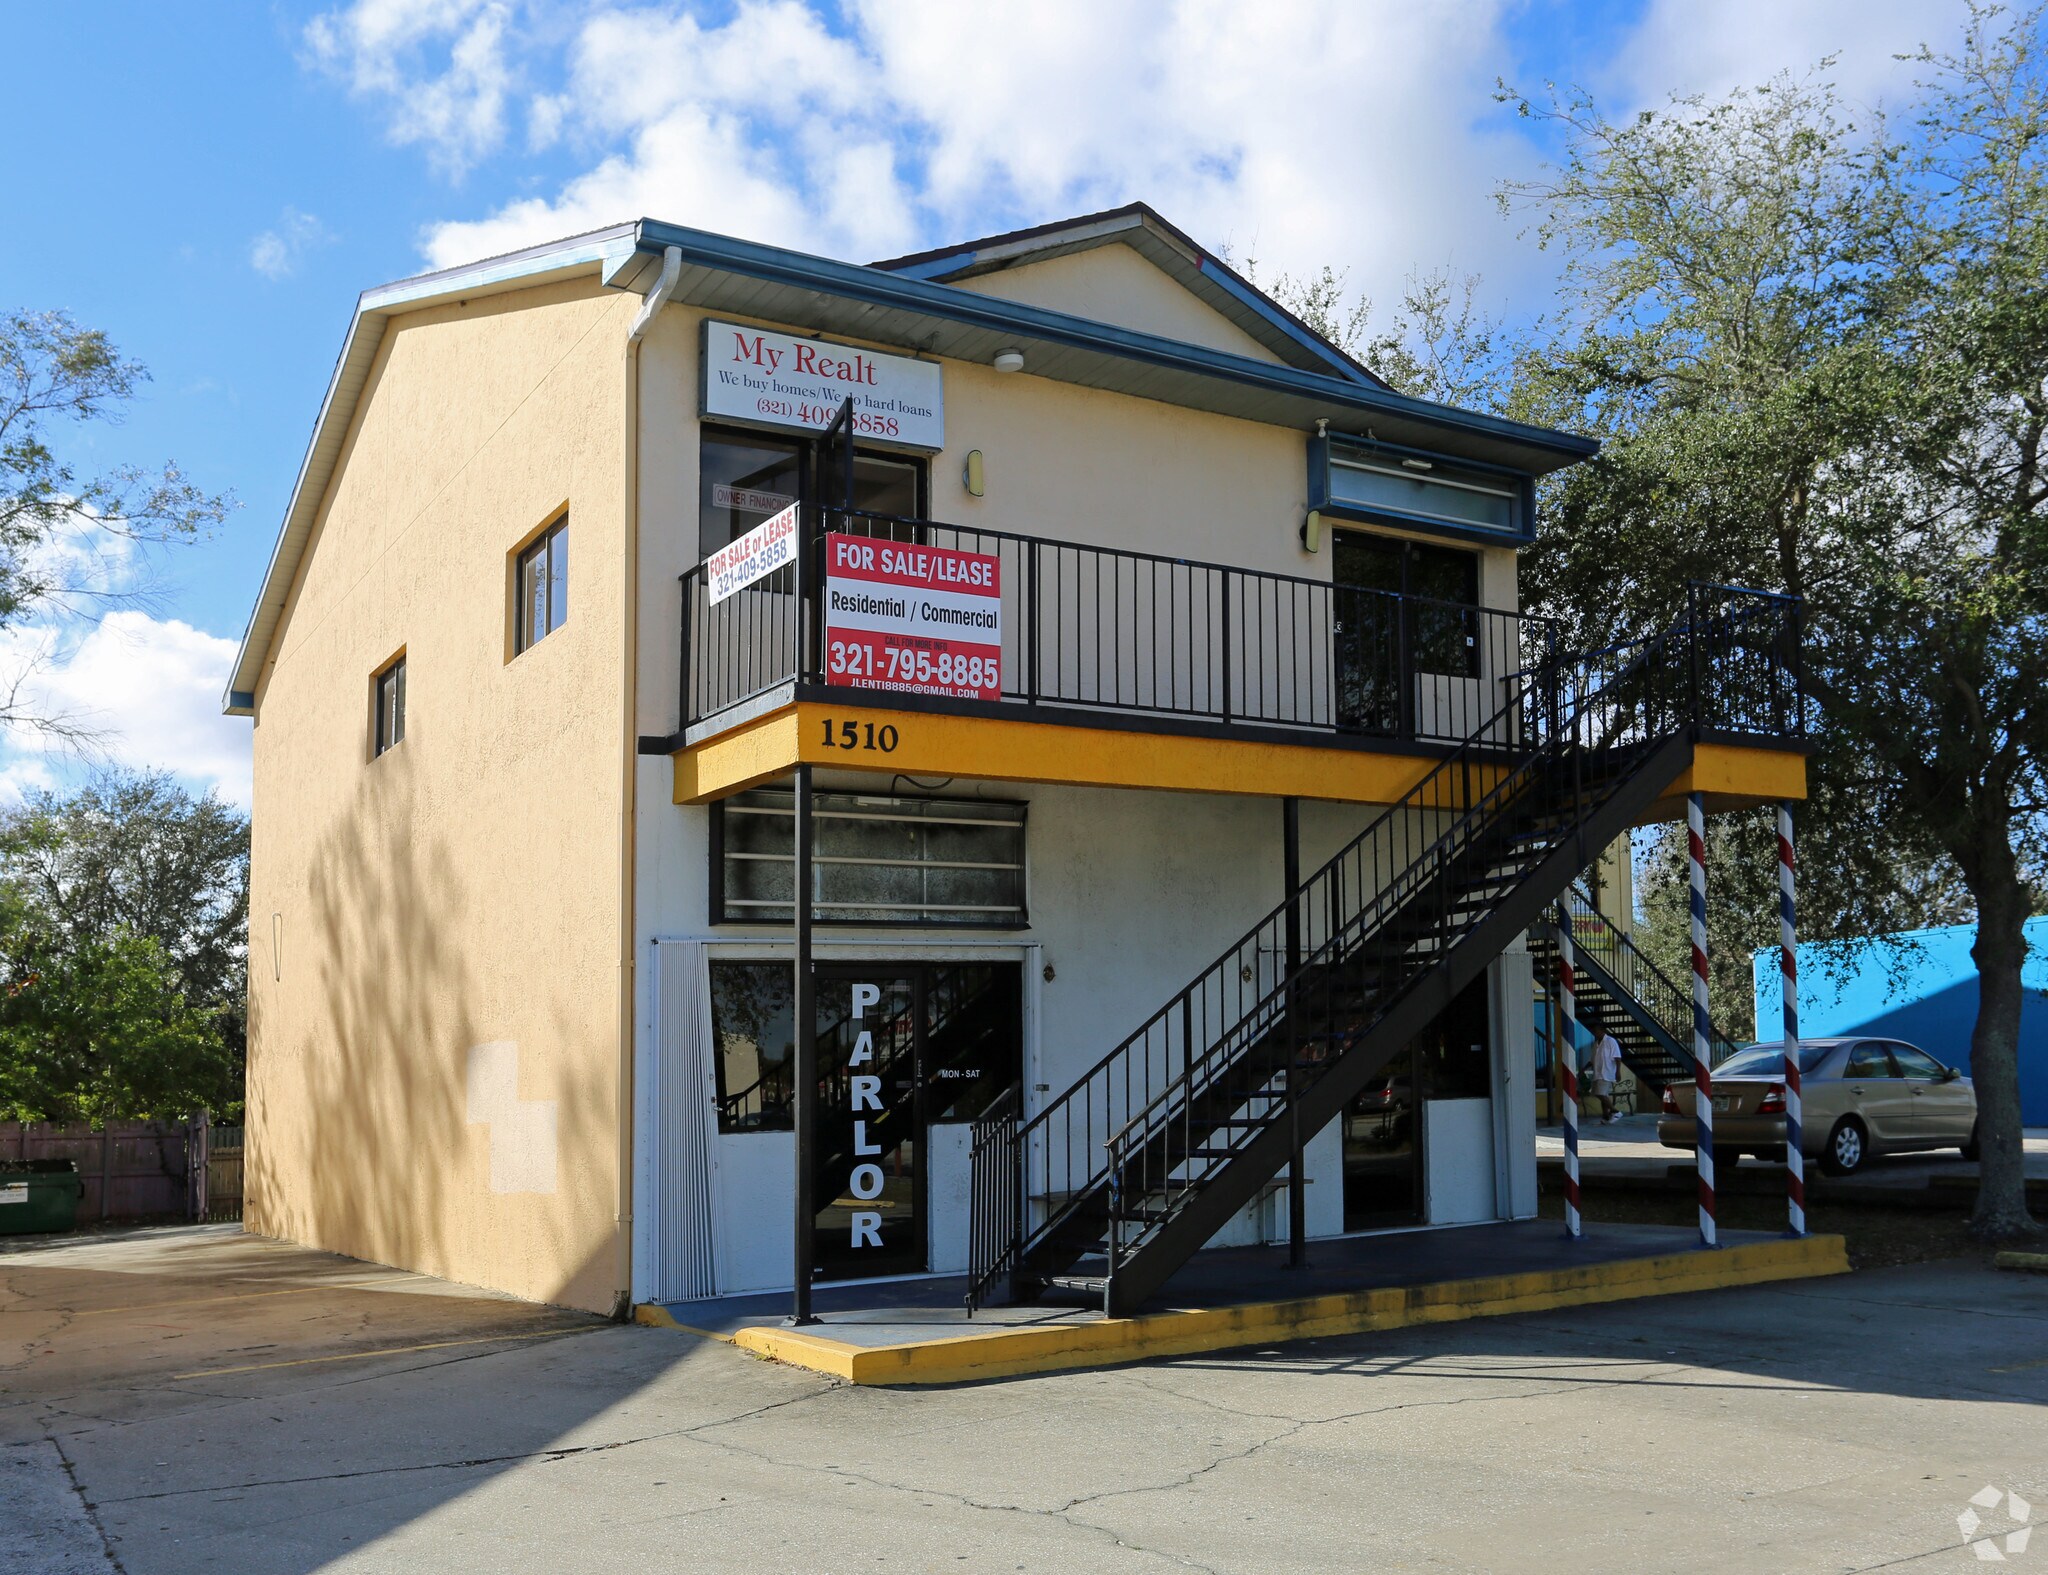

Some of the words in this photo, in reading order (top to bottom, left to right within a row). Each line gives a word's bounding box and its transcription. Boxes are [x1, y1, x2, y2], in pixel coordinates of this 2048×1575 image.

[733, 332, 784, 375] My
[793, 343, 878, 386] Realt
[718, 370, 739, 386] We
[744, 375, 769, 393] buy
[772, 379, 841, 402] homes/We
[865, 395, 894, 411] hard
[899, 401, 932, 418] loans
[757, 397, 793, 418] (321)
[717, 489, 745, 505] OWNER
[710, 553, 726, 580] FOR
[728, 537, 750, 568] SALE
[752, 536, 761, 554] or
[764, 511, 793, 547] LEASE
[836, 542, 874, 571] FOR
[881, 549, 992, 587] SALE/LEASE
[832, 591, 905, 618] Residential
[910, 601, 917, 622] /
[921, 602, 997, 629] Commercial
[885, 636, 900, 646] CALL
[902, 638, 913, 648] FOR
[915, 639, 932, 649] MORE
[934, 642, 947, 651] INFO
[830, 641, 998, 689] 321-795-8885
[851, 678, 979, 699] JLENTI8885@GMAIL.COM
[822, 719, 898, 752] 1510
[942, 1070, 960, 1078] MON
[966, 1069, 980, 1078] SAT
[849, 983, 884, 1248] PARLOR
